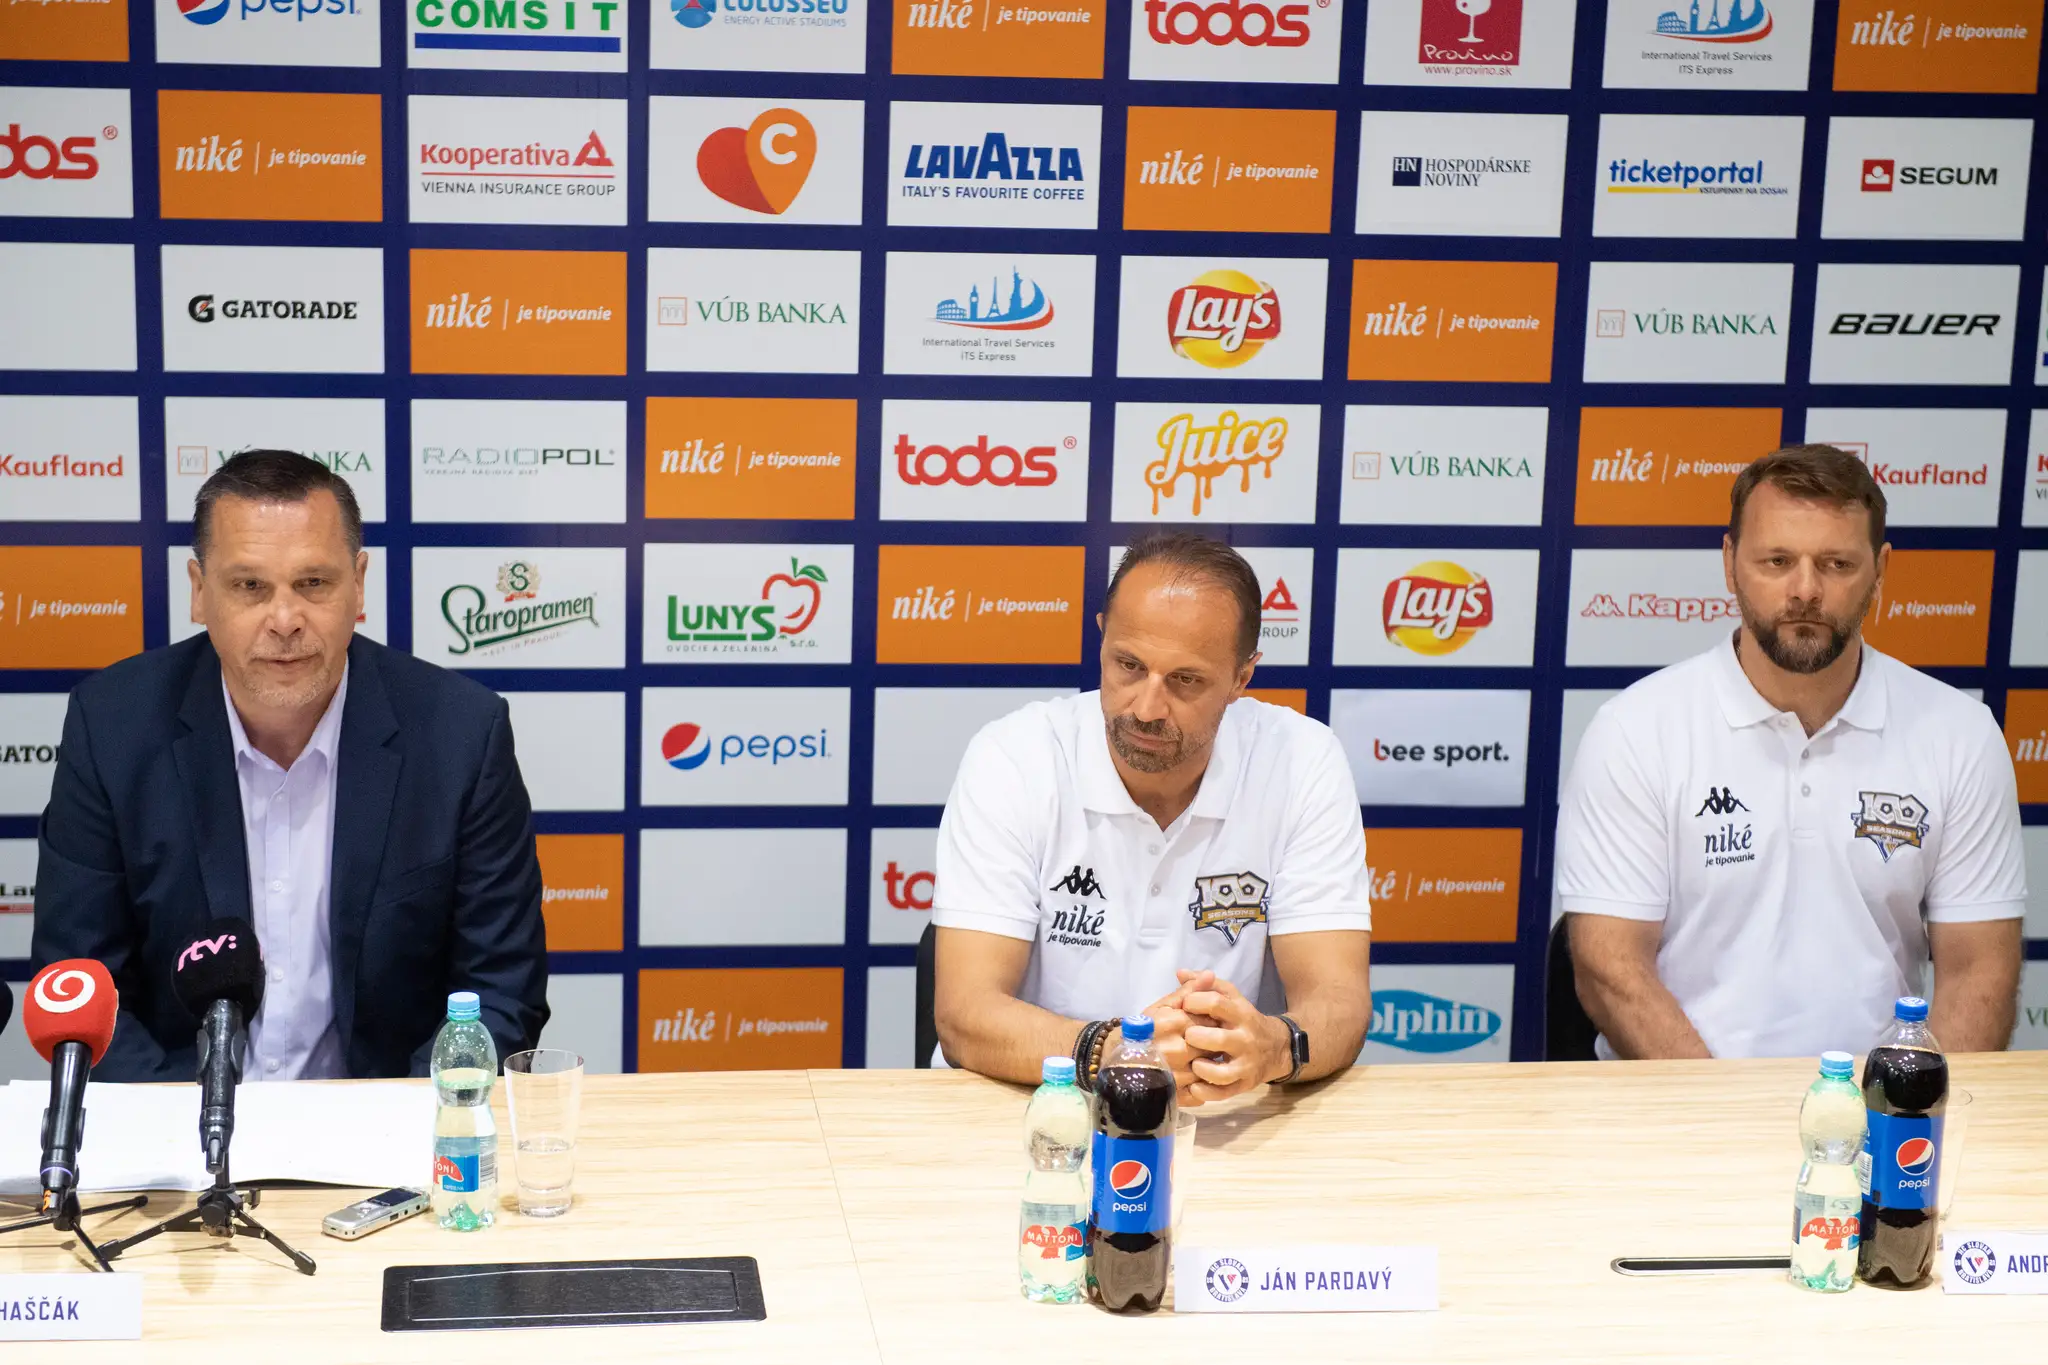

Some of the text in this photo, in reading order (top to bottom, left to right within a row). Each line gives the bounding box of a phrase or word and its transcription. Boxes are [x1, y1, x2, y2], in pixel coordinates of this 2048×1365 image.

[724, 15, 847, 27] ENERGY ACTIVE STADIUMS
[908, 0, 1090, 29] niké je tipovanie
[1145, 0, 1310, 47] todos
[1850, 10, 2027, 46] niké je tipovanie
[1424, 44, 1513, 61] Provino
[1641, 51, 1772, 61] International Travel Services
[1425, 66, 1512, 76] www.provino.sk
[1678, 65, 1733, 75] ITS Express
[175, 135, 366, 172] niké je tipovanie
[420, 143, 570, 171] Kooperativa
[904, 132, 1084, 181] LAVAZZA
[1394, 156, 1531, 174] HN HOSPODÁRSKE
[1140, 150, 1318, 186] niké je tipovanie
[1425, 174, 1480, 187] NOVINY
[1610, 159, 1763, 189] ticketportal
[1900, 167, 1998, 186] SEGUM
[421, 181, 615, 196] VIENNA INSURANCE GROUP
[902, 185, 1084, 200] ITALY'S FAVOURITE COFFEE
[222, 300, 358, 320] GATORADE
[426, 293, 612, 329] niké je tipovanie
[697, 296, 847, 325] VÚB BANKA
[1175, 288, 1275, 352] Lay's
[1364, 302, 1540, 337] niké je tipovanie
[1633, 307, 1778, 335] VÚB BANKA
[922, 338, 1055, 348] International Travel Services
[978, 352, 1016, 361] Express
[422, 447, 615, 466] RADIOPOL
[660, 440, 841, 474] niké je tipovanie
[894, 434, 1058, 487] todos
[1144, 410, 1288, 486] Juice
[0, 454, 124, 477] Kaufland
[1389, 451, 1534, 478] VÚB BANKA
[1591, 448, 1752, 482] niké je tipova
[1873, 464, 1988, 485] Kaufland
[30, 599, 127, 618] je tipovanie
[891, 586, 1069, 620] niké je tipovanie
[1388, 578, 1487, 640] Lay's
[1888, 600, 1976, 620] je tipovanie
[441, 584, 599, 655] Staropramen
[668, 595, 776, 641] LUNYS
[1262, 626, 1299, 638] ROUP
[0, 745, 61, 763] ATO
[720, 728, 827, 765] pepsi
[1374, 739, 1509, 767] bee sport.
[1859, 791, 1928, 828] 100
[1704, 823, 1752, 853] niké
[1705, 852, 1755, 867] je tipovanie
[542, 884, 609, 904] ipovanie
[1196, 871, 1268, 909] 100
[1368, 867, 1505, 899] ké je tipovanie
[1051, 904, 1105, 936] niké
[1047, 931, 1102, 947] je tipovanie
[653, 1008, 829, 1041] niké je tipovanie
[434, 1161, 454, 1174] TONI
[1898, 1177, 1931, 1190] pepsi
[1112, 1201, 1147, 1214] pepsi
[1027, 1231, 1078, 1244] MATTONI
[1808, 1223, 1858, 1234] MATTONI
[1260, 1266, 1392, 1291] JÁN PARDAVÝ
